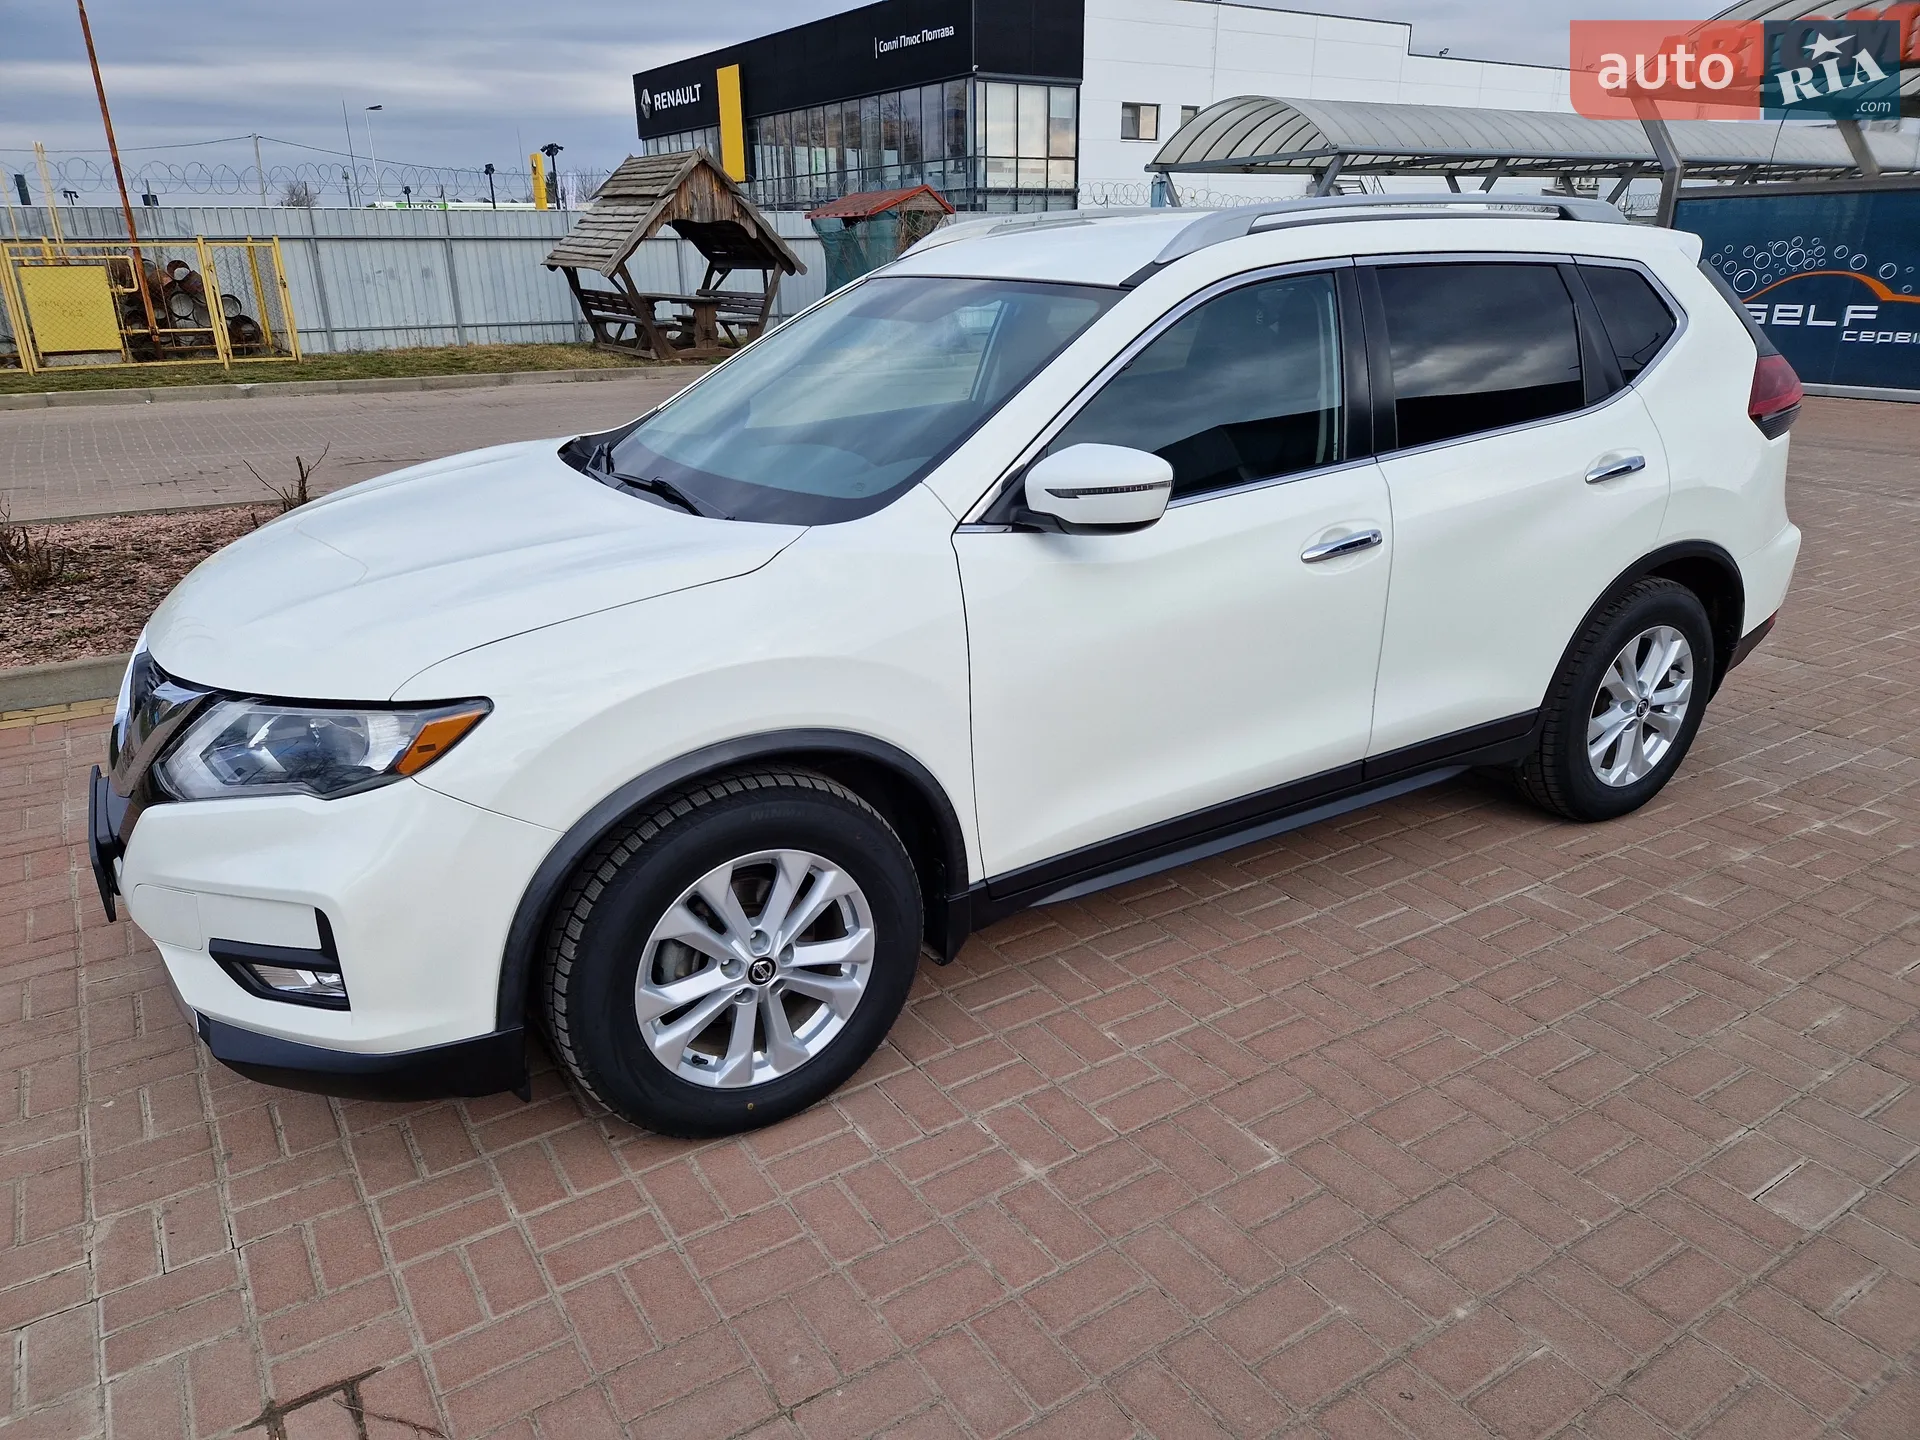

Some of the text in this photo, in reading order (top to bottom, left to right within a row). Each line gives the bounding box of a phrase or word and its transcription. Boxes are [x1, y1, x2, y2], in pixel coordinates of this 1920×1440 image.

[879, 26, 955, 53] Соллі Плюс Полтава
[654, 83, 702, 111] RENAULT
[1841, 330, 1920, 344] серві
